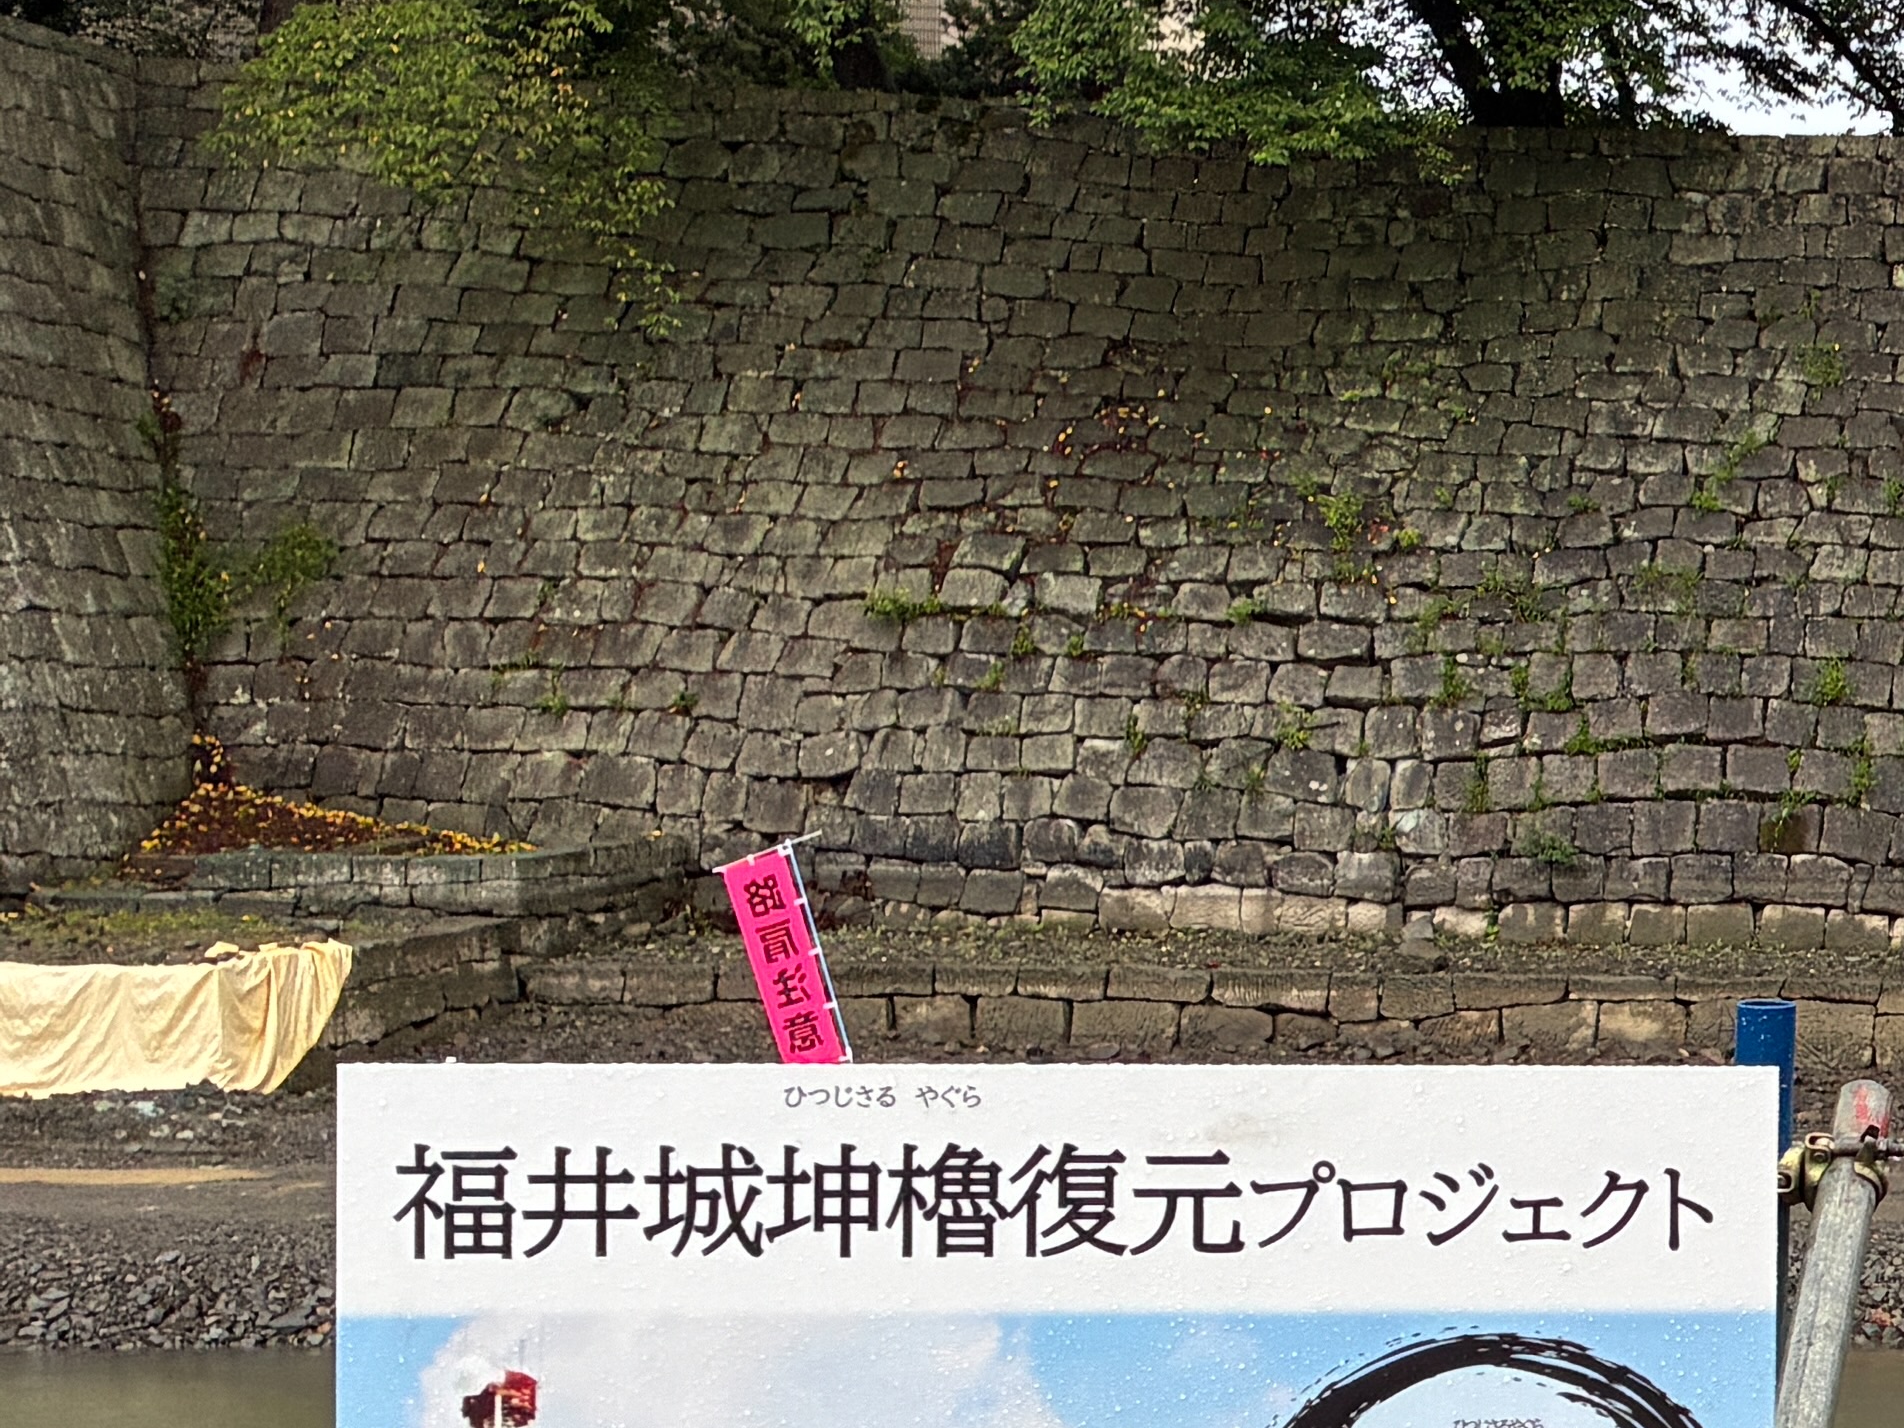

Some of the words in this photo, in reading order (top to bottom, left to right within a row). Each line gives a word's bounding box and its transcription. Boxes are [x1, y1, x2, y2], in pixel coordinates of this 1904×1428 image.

[783, 1085, 895, 1109] ひつじさる
[915, 1085, 982, 1109] やぐら
[392, 1142, 1714, 1260] 福井城坤櫓復元プロジェクト
